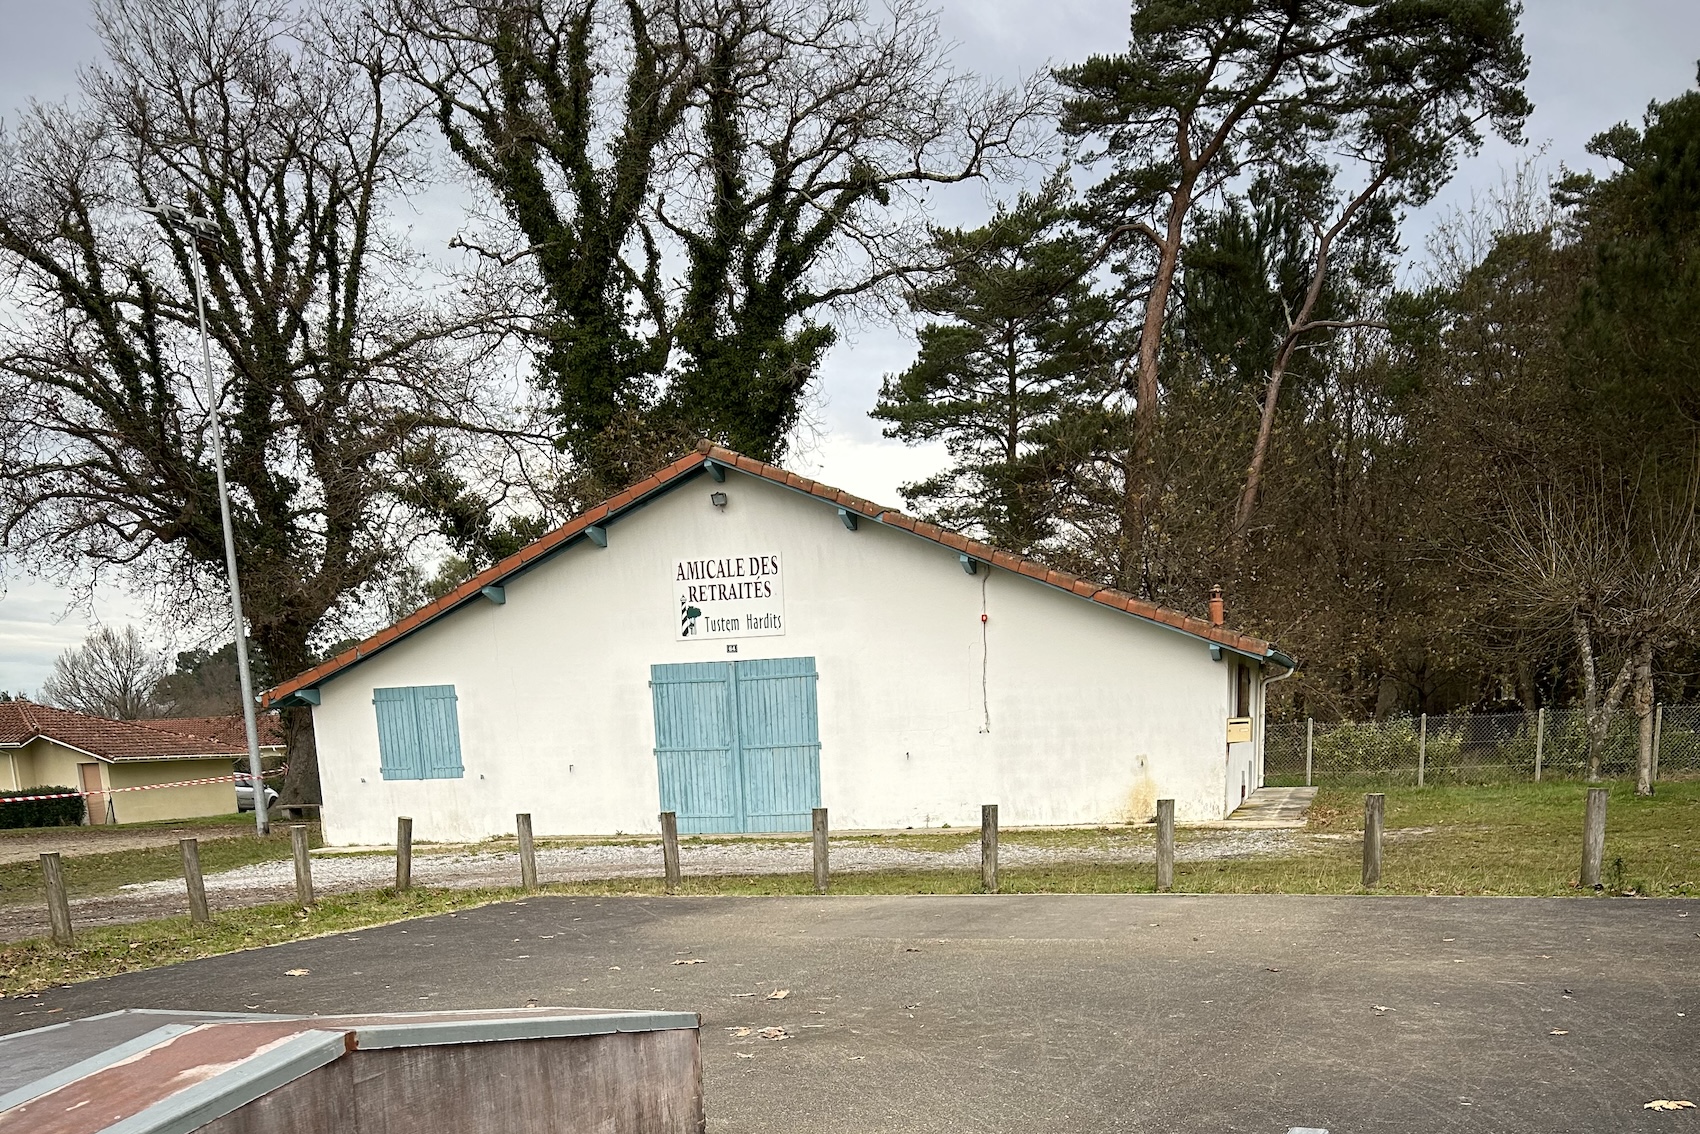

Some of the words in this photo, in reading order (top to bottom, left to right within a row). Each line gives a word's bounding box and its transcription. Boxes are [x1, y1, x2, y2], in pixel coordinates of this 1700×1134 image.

[676, 558, 745, 581] AMICALE
[749, 555, 778, 576] DES
[688, 576, 771, 602] RETRAITÉS
[705, 616, 740, 632] Tustem
[746, 613, 782, 630] Hardits
